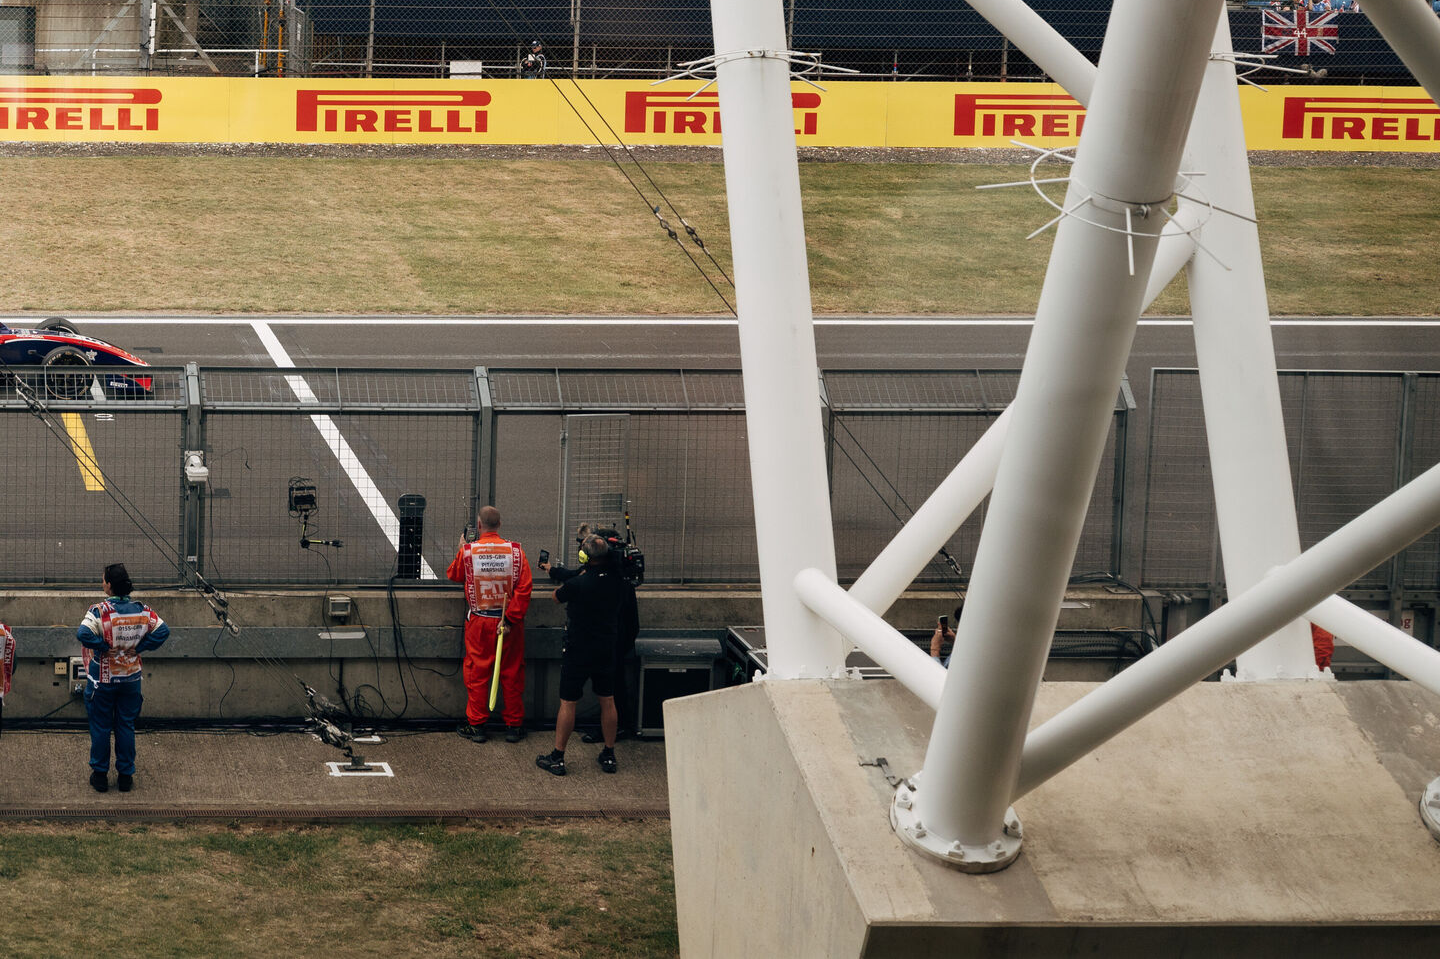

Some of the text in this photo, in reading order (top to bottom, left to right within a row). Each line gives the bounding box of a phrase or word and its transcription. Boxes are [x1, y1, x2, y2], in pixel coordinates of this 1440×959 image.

[1293, 27, 1308, 38] 44
[296, 90, 492, 133] PIRELLI
[624, 91, 822, 135] PIRI
[953, 94, 1087, 137] PIRE
[1282, 97, 1440, 141] PIREL
[479, 581, 508, 594] PIT
[115, 635, 141, 643] PARAMEDI
[101, 657, 109, 683] BRITA
